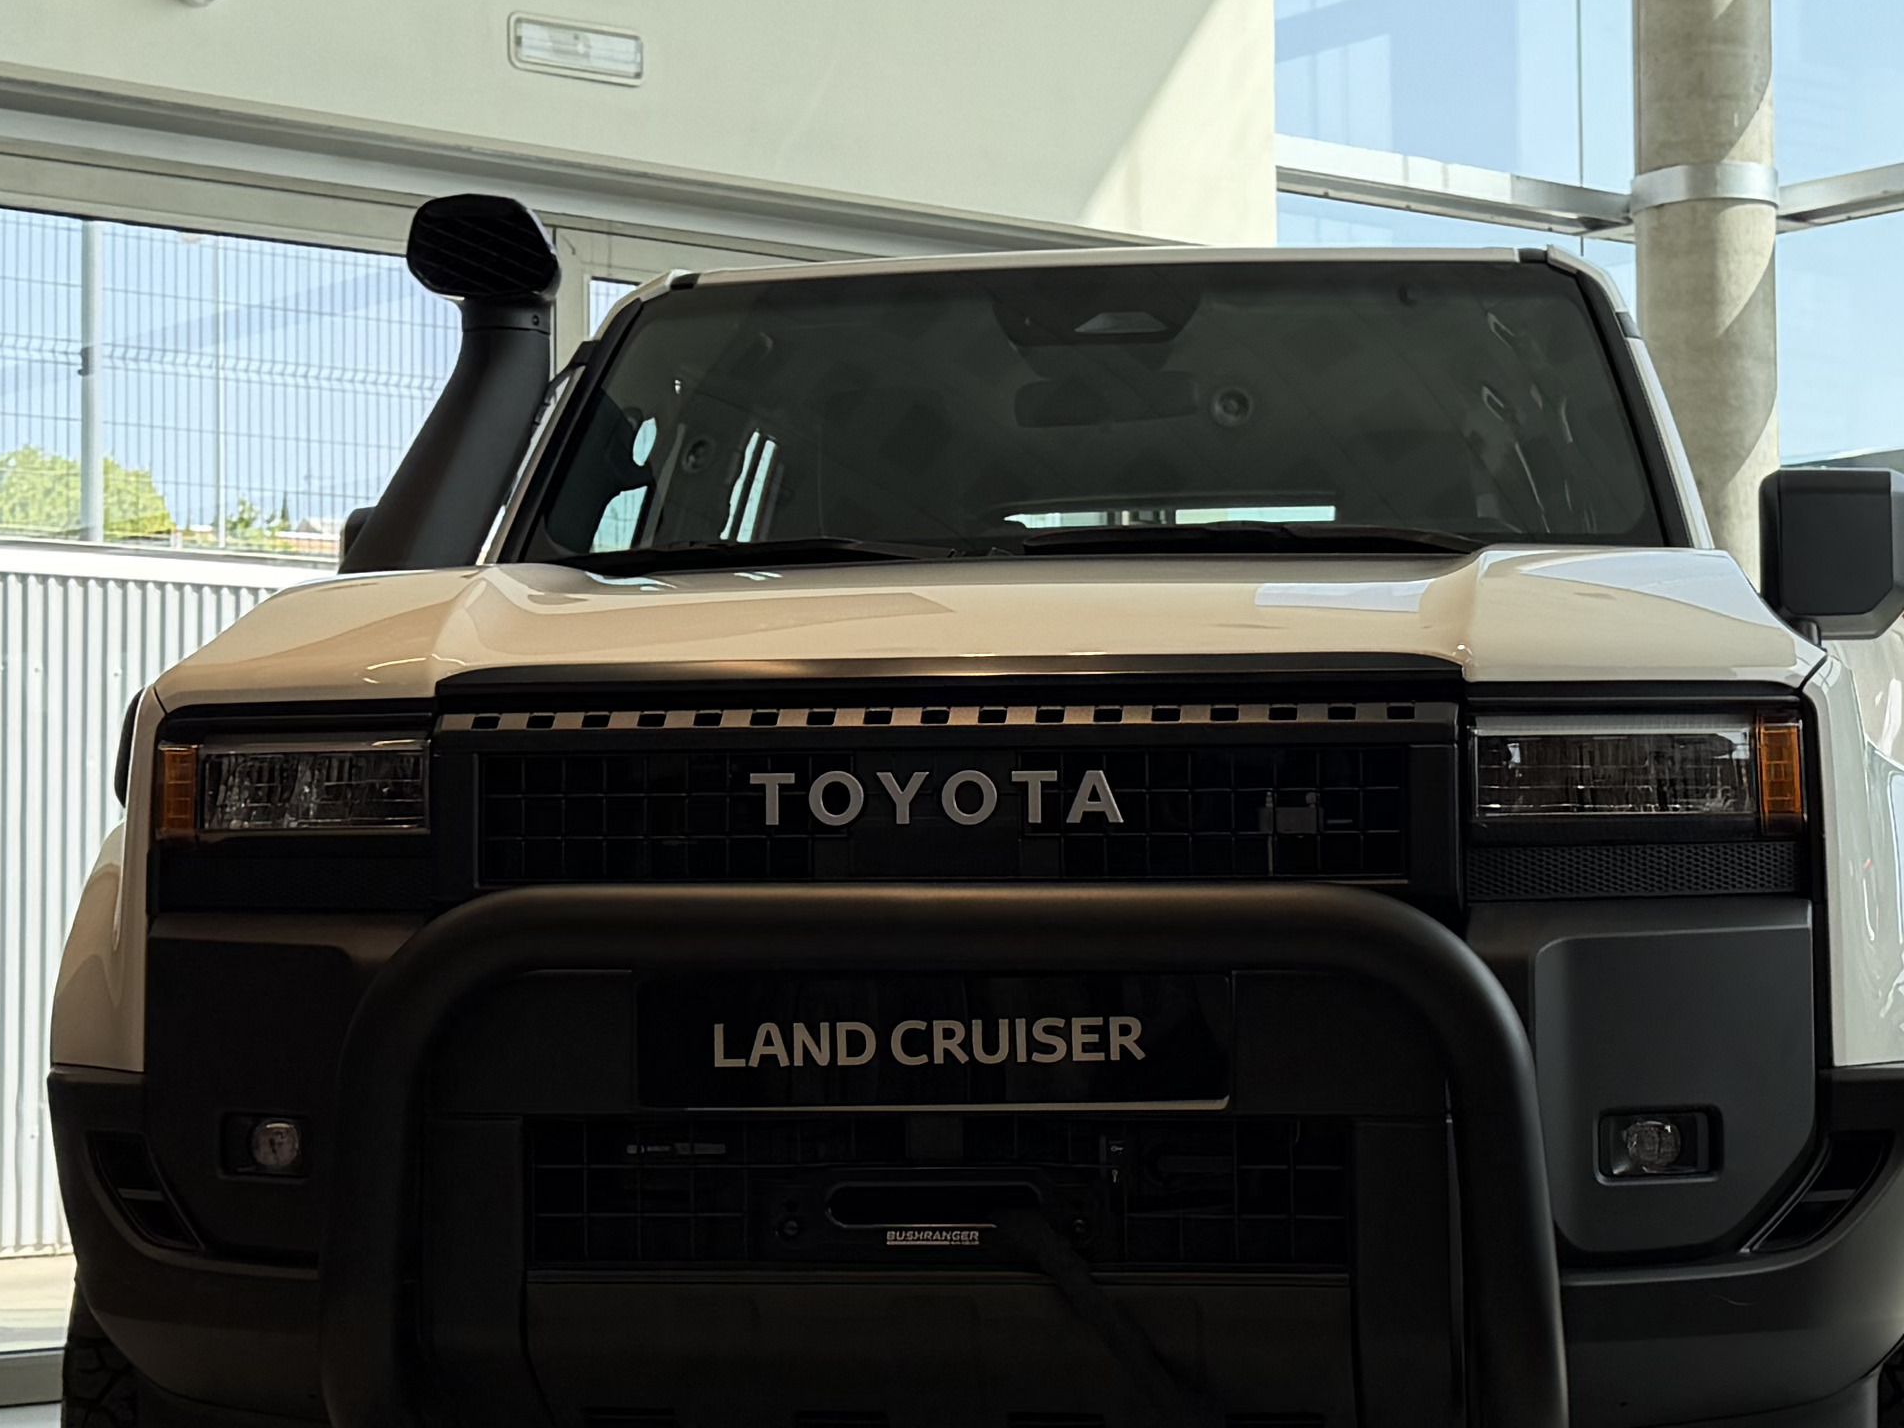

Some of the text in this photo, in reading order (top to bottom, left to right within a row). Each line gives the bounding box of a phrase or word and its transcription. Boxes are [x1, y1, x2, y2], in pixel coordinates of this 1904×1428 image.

[749, 770, 1124, 826] TOYOTA
[713, 1016, 1146, 1067] LAND CRUISER
[886, 1230, 980, 1241] BUSHRANGER
